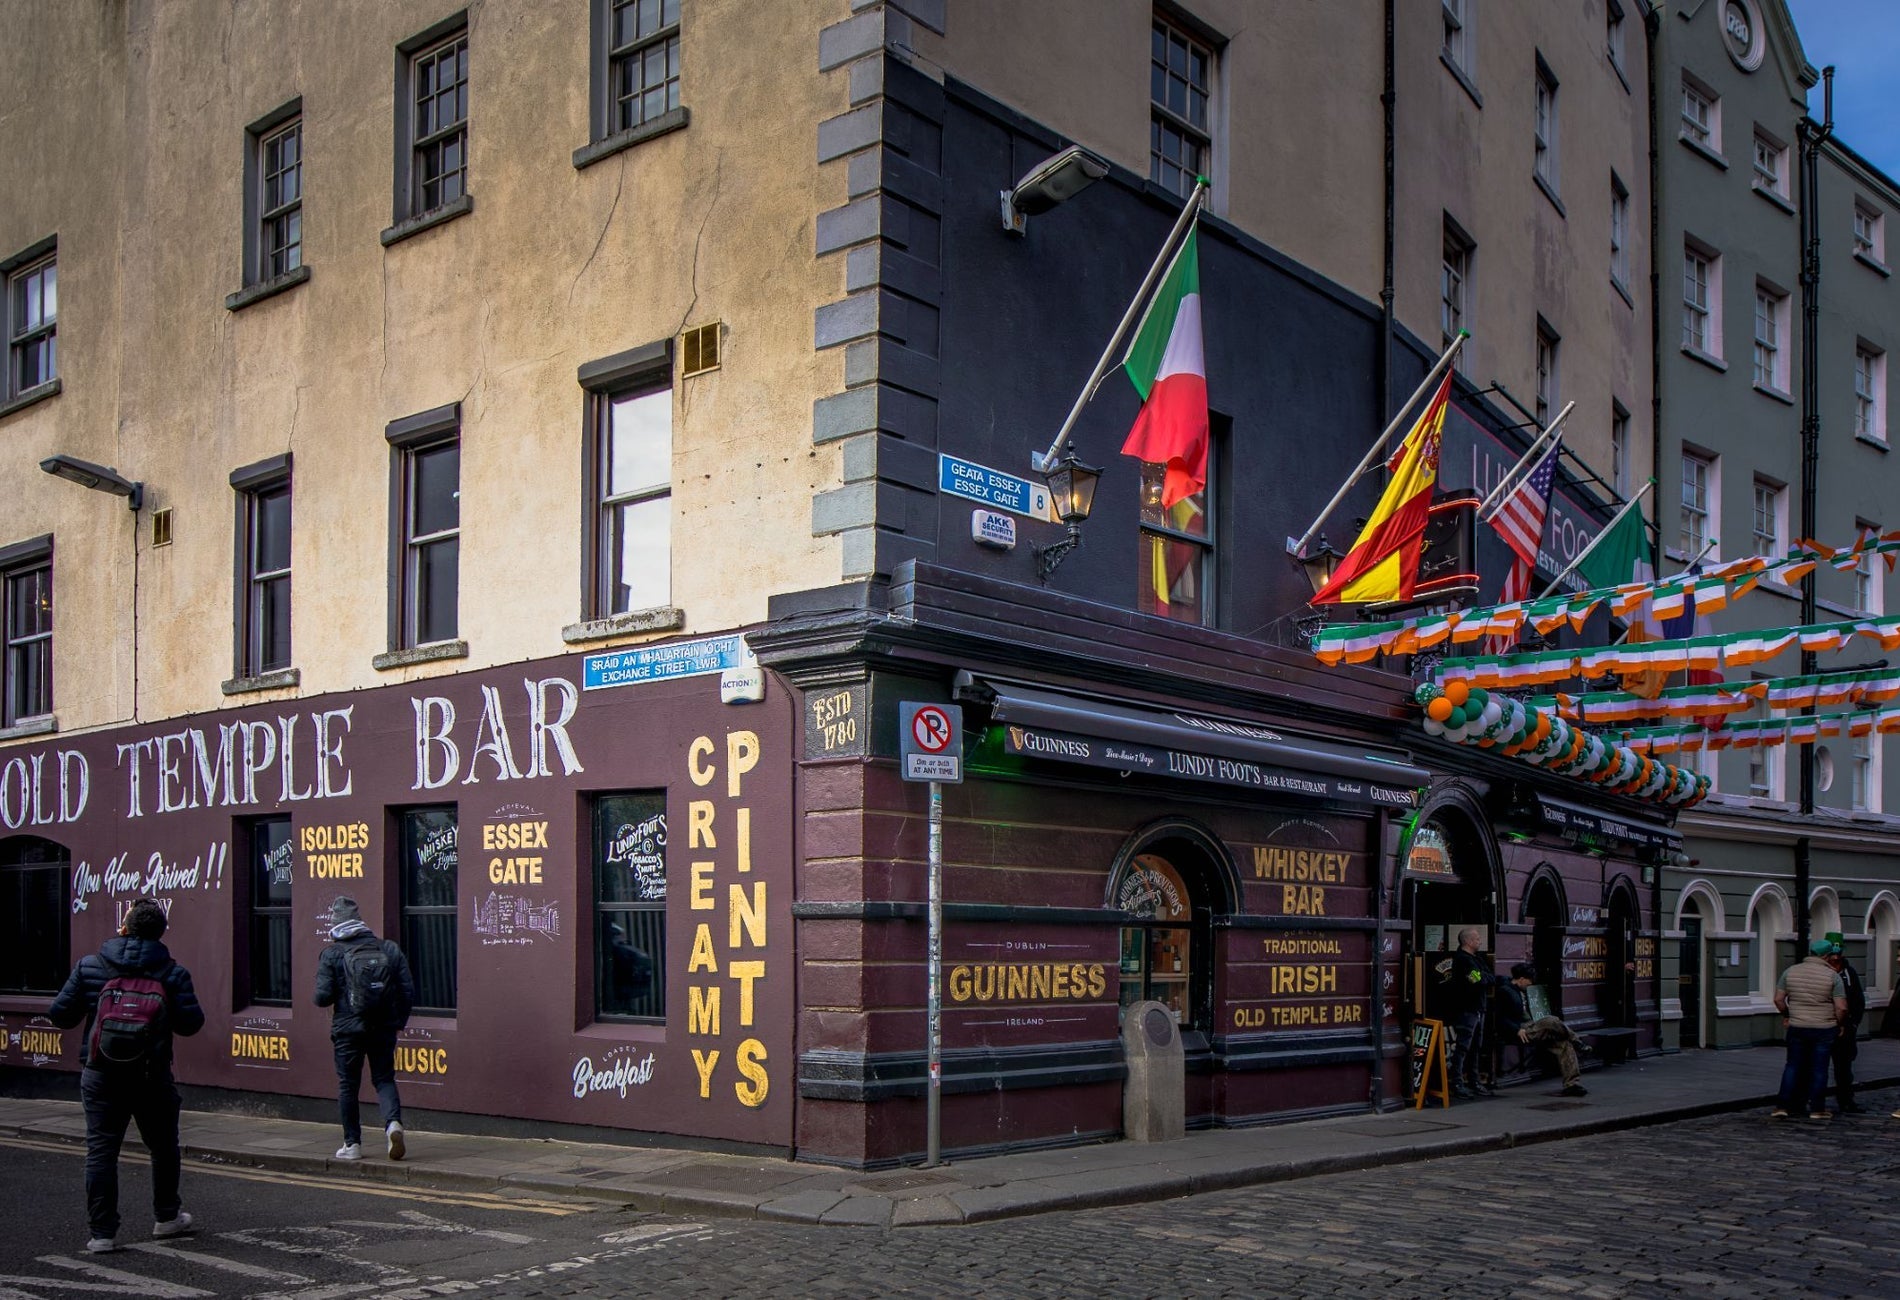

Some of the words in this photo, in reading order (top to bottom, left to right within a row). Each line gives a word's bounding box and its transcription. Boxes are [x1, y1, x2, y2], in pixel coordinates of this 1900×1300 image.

[951, 463, 985, 483] GEATA
[988, 475, 1022, 495] ESSEX
[954, 479, 989, 499] ESSEX
[993, 490, 1020, 508] GATE
[1036, 494, 1044, 510] 8
[982, 522, 1014, 537] SECURITY
[987, 514, 1010, 528] AKK
[591, 656, 619, 671] SRÁID
[623, 655, 637, 667] AN
[601, 666, 650, 683] EXCHANGE
[655, 660, 691, 676] STREET
[824, 718, 856, 751] 1780
[1174, 713, 1282, 741] GUINNESS
[1, 750, 89, 830] OLD
[117, 704, 354, 819] TEMPLE
[411, 677, 585, 790] BAR
[1023, 732, 1090, 758] GUINNESS
[923, 767, 937, 775] ANY
[939, 768, 953, 776] TIME
[1167, 751, 1215, 778] LUNDY
[1218, 759, 1262, 785] FOOT'S
[1263, 774, 1279, 788] BAR
[1279, 778, 1286, 788] &
[1286, 778, 1328, 794] RESTAURANT
[1370, 785, 1412, 804] GUINNESS
[416, 825, 459, 866] WHISKEY
[483, 821, 549, 850] ESSEX
[606, 829, 640, 863] LUNDY
[263, 839, 293, 872] WINES
[307, 853, 364, 879] TOWER
[1253, 847, 1351, 883] WHISKEY
[73, 861, 101, 915] You
[104, 851, 141, 898] Have
[141, 851, 201, 897] Arrived
[489, 857, 544, 885] GATE
[1282, 885, 1325, 916] BAR
[688, 735, 721, 1099] CREAMY
[727, 730, 769, 1108] PINTS
[1005, 941, 1047, 950] DUBLIN
[1263, 939, 1342, 954] TRADITIONAL
[1635, 937, 1655, 957] IRISH
[1271, 965, 1337, 994] IRISH
[1636, 959, 1654, 977] BAR
[950, 963, 1107, 1002] GUINNESS
[1006, 1018, 1045, 1027] IRELAND
[1233, 1008, 1266, 1028] OLD
[1271, 1006, 1328, 1026] TEMPLE
[1333, 1004, 1362, 1023] BAR
[22, 1030, 63, 1056] DRINK
[231, 1033, 290, 1061] DINNER
[602, 1045, 638, 1062] LOADED
[394, 1046, 448, 1075] MUSIC
[573, 1052, 656, 1100] Breakfast
